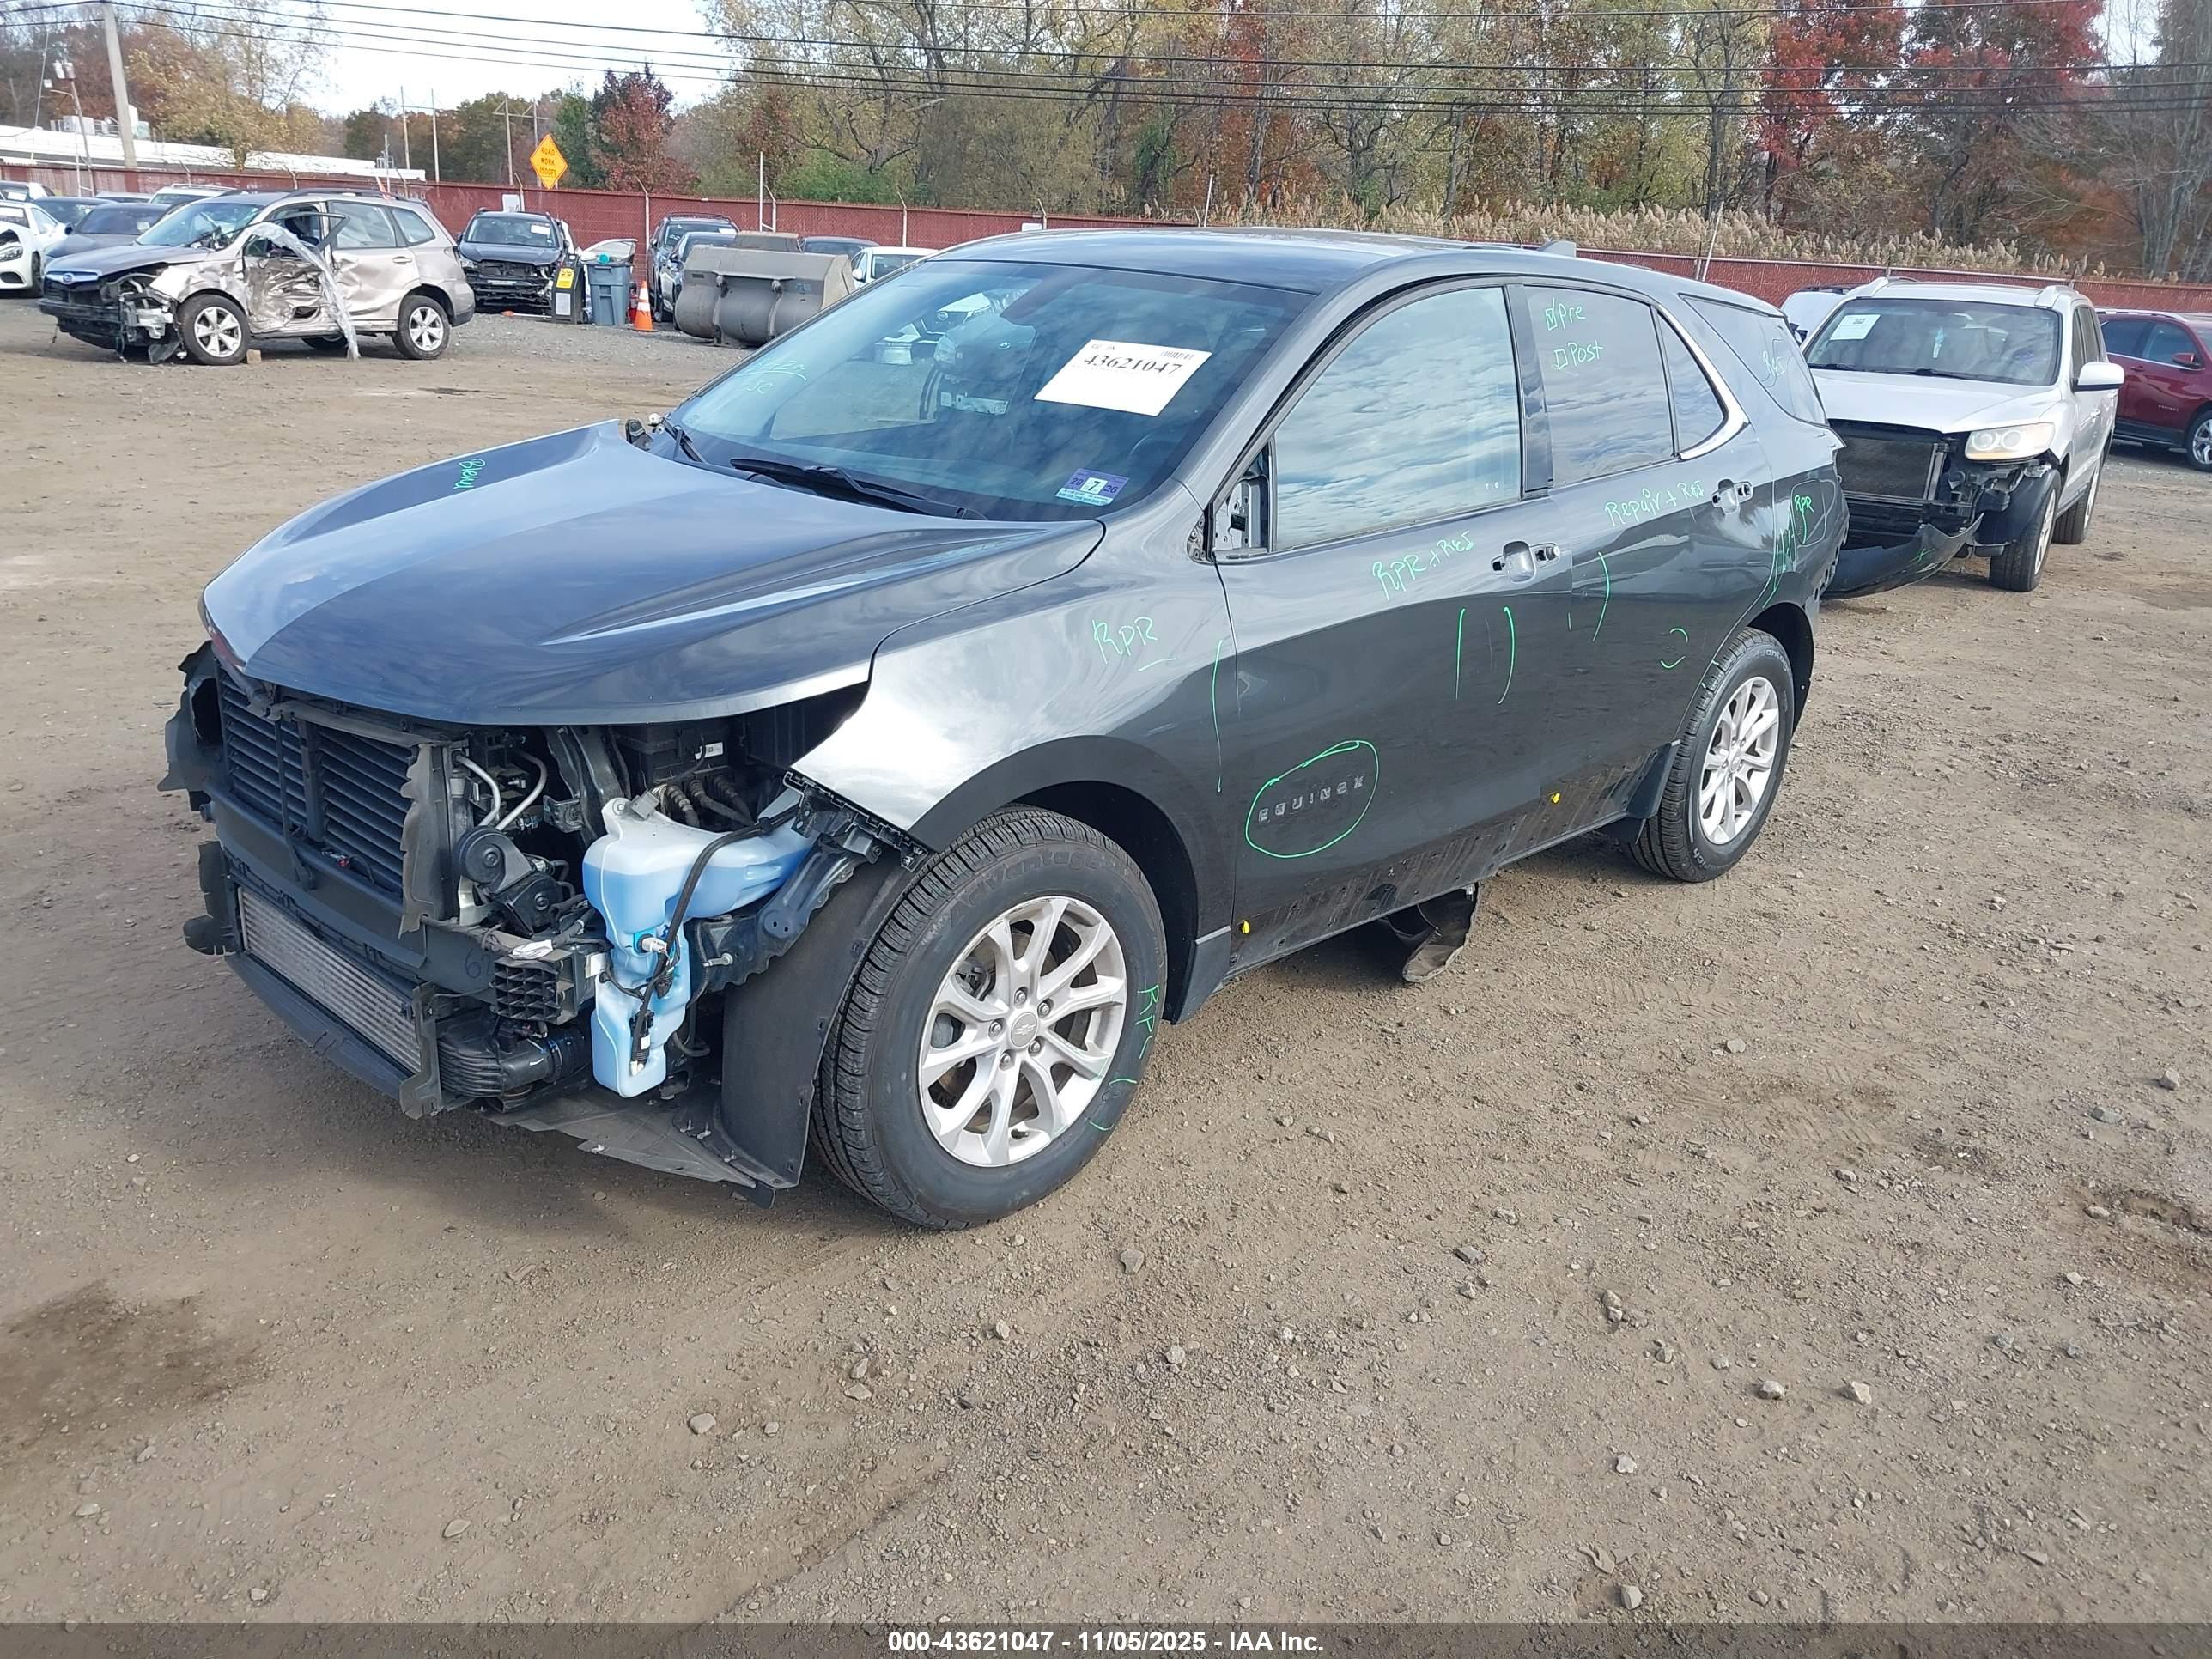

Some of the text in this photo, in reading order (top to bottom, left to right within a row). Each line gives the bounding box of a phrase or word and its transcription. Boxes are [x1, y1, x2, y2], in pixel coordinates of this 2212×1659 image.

[541, 147, 556, 156] ROAD
[541, 157, 555, 166] WORK
[1083, 353, 1185, 375] 43621047
[1567, 339, 1604, 367] Post
[1069, 477, 1119, 494] 20 7 26
[1604, 487, 1661, 526] Repair
[1091, 617, 1158, 665] RPR
[1258, 775, 1366, 823] EQUINOX
